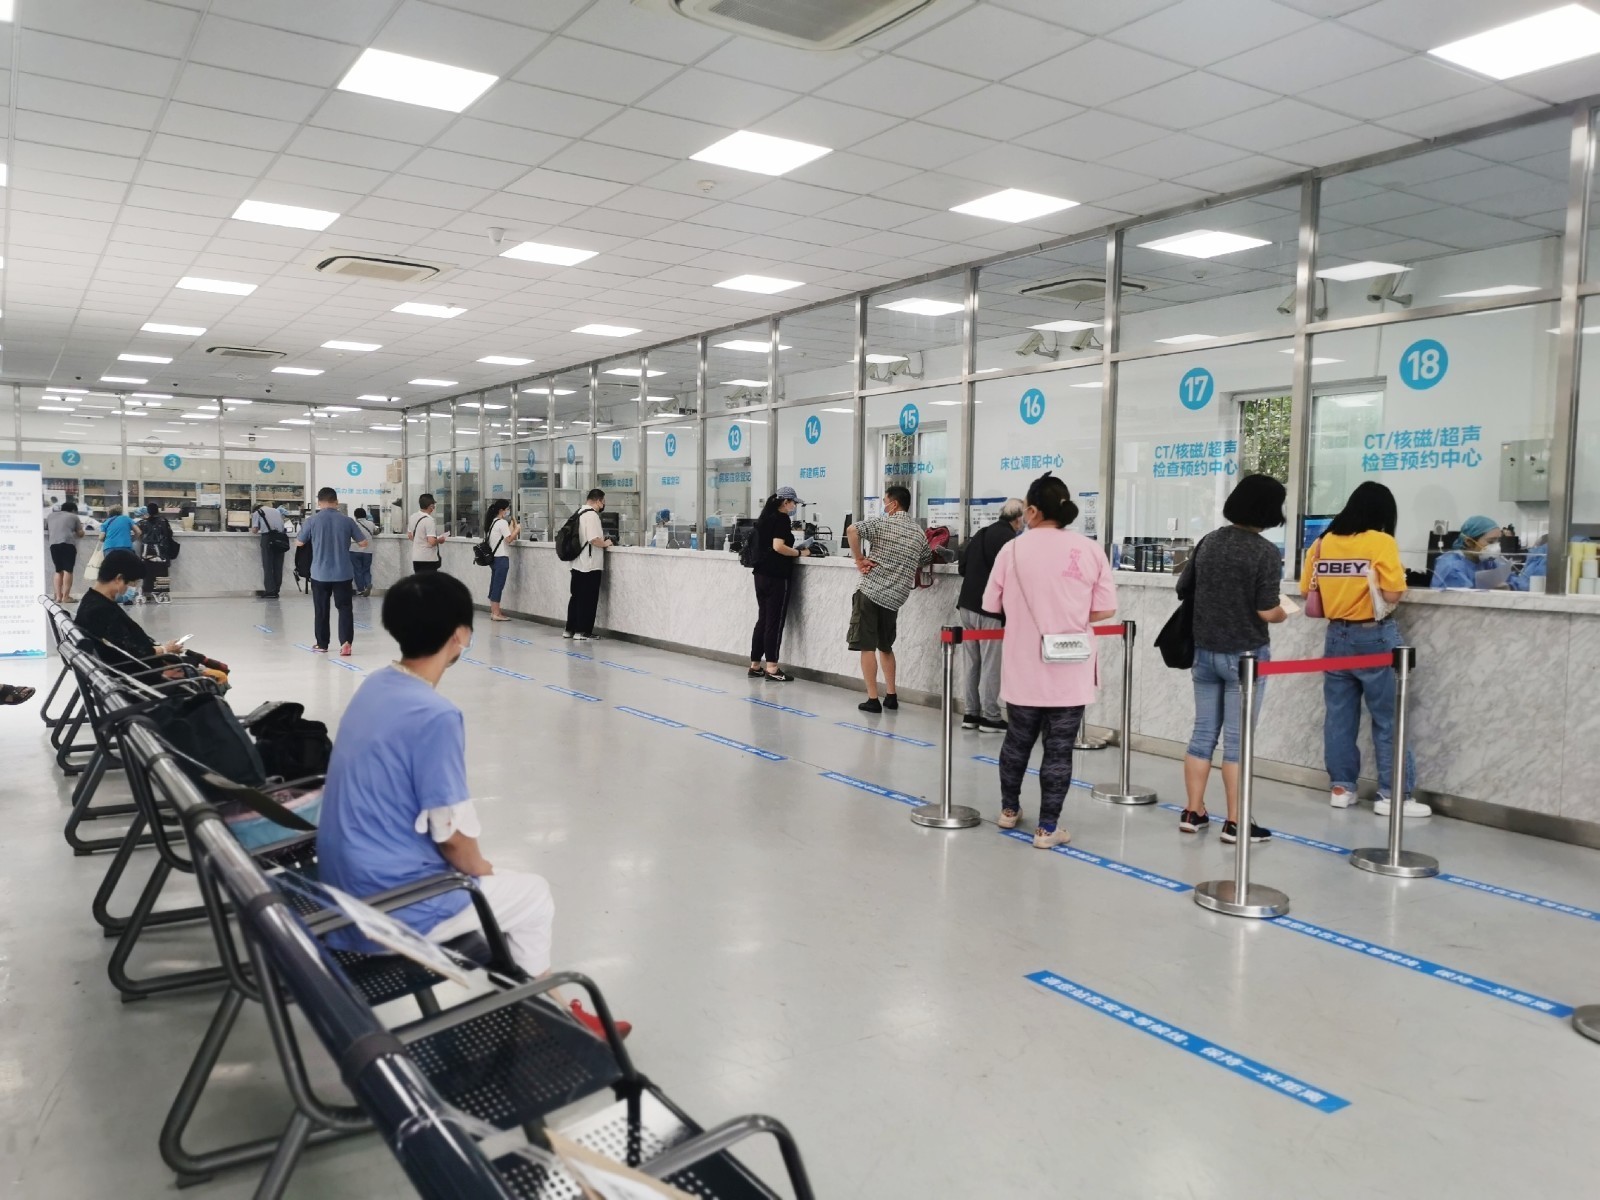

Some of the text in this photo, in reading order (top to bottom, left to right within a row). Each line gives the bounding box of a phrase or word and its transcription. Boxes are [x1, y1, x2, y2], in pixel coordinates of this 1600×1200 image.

[1407, 348, 1440, 380] 18
[1184, 375, 1209, 402] 17
[1024, 395, 1041, 418] 16
[902, 409, 916, 430] 15
[729, 429, 741, 447] 13
[806, 420, 820, 438] 14
[1364, 425, 1482, 450] CT/核磁/超声
[612, 443, 621, 458] 11
[666, 438, 676, 453] 12
[1154, 440, 1238, 460] CT/核磁/超声
[67, 453, 76, 463] 2
[169, 456, 177, 467] 3
[262, 460, 271, 471] 4
[1000, 453, 1065, 471] 床位调配中心
[1361, 447, 1483, 472] 检查预约中心
[351, 464, 358, 474] 5
[800, 466, 826, 479] 新建病历
[884, 461, 934, 476] 床位调配中心
[1153, 459, 1238, 478] 检查预约中心
[1317, 562, 1367, 574] OBEY
